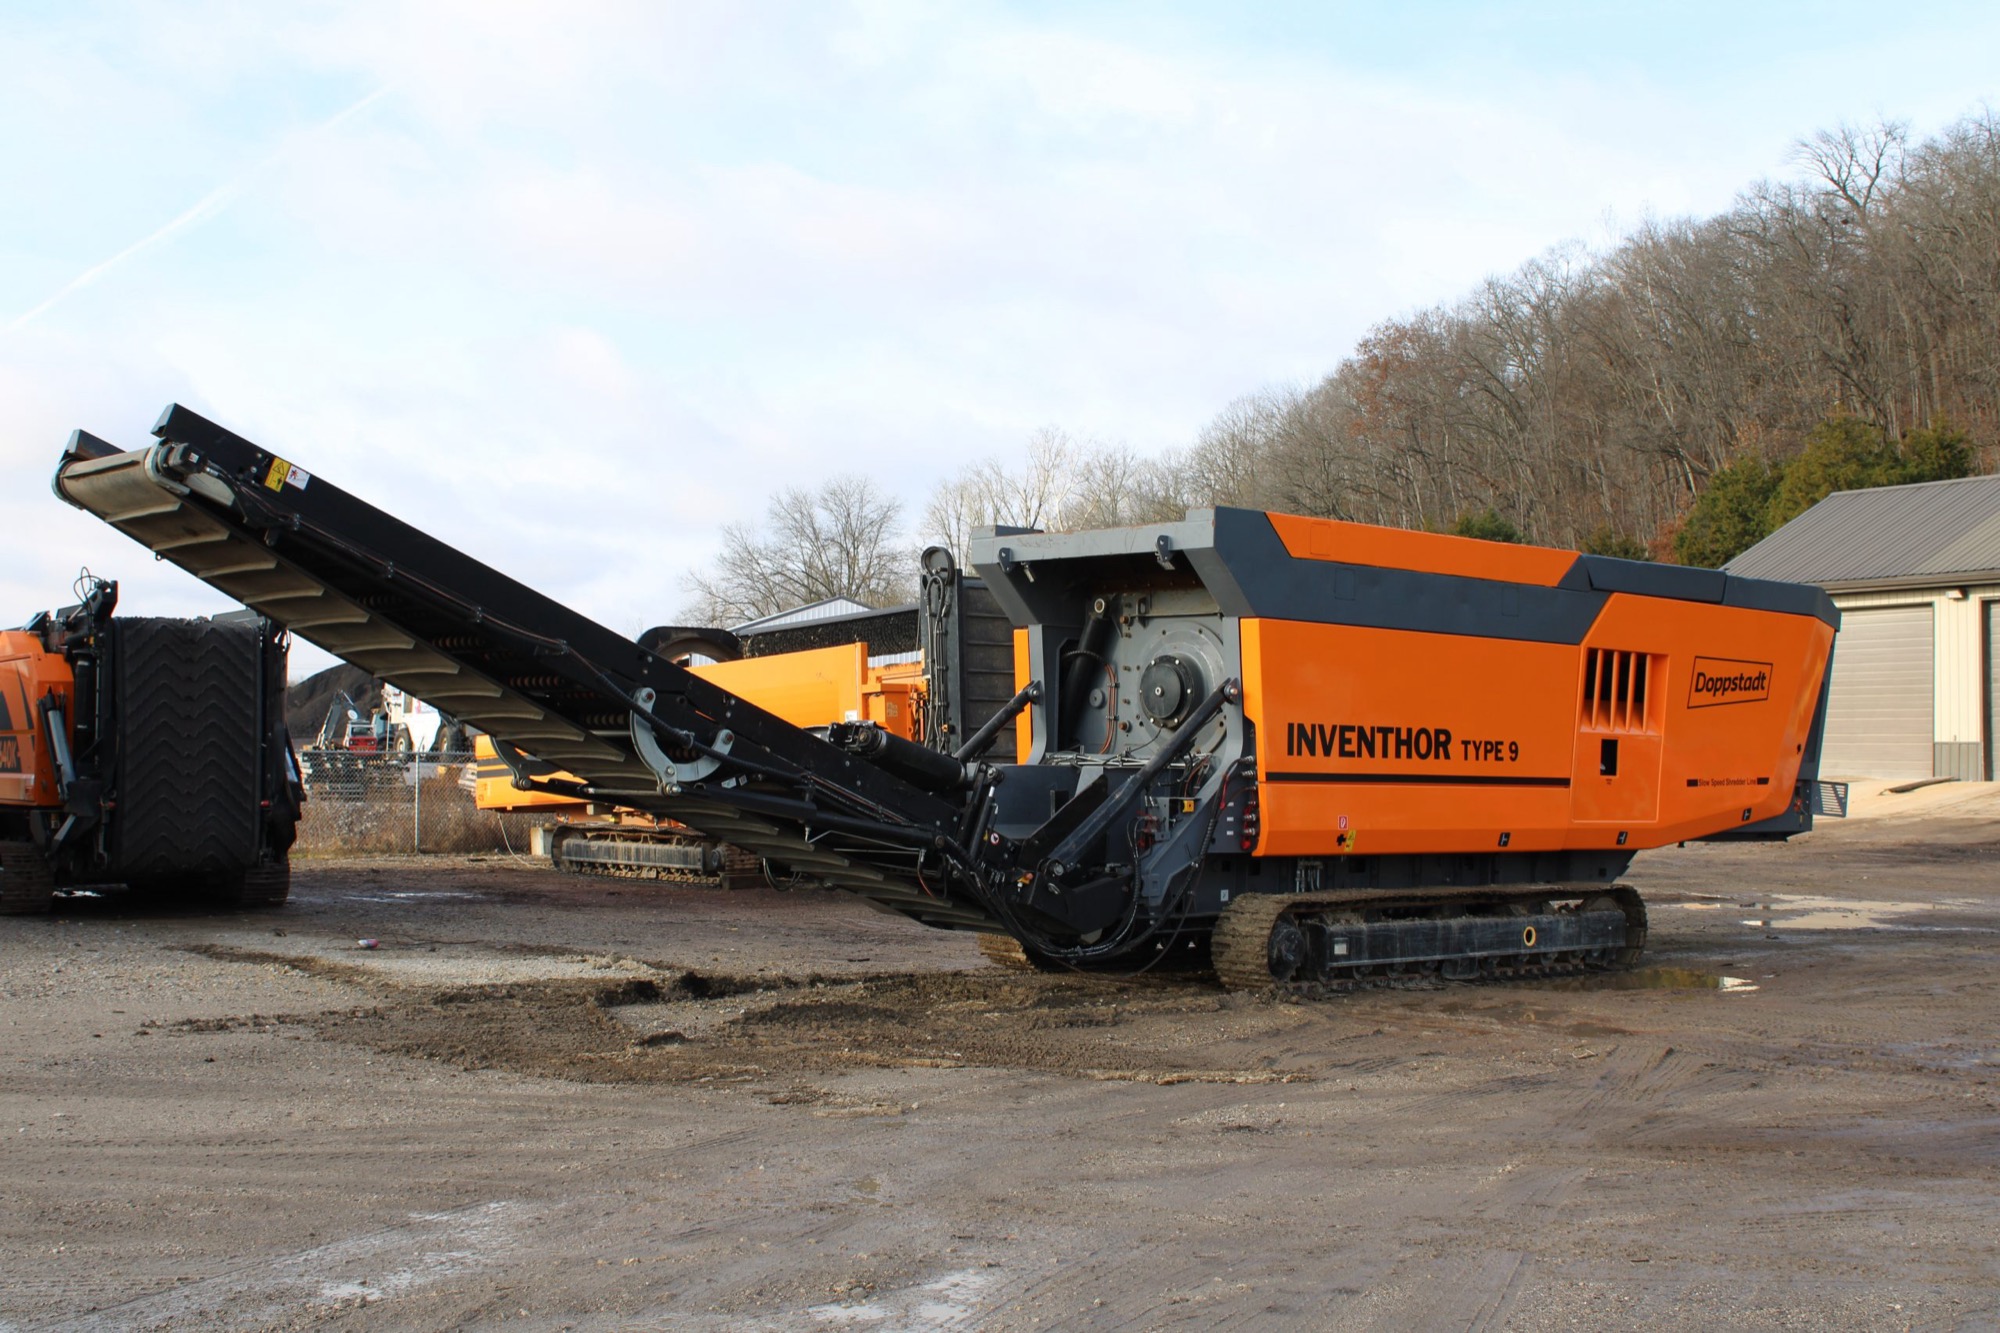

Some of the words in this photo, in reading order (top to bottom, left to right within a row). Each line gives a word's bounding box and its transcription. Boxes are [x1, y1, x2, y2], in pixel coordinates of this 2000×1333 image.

[1694, 671, 1766, 697] Doppstadt
[1286, 722, 1452, 760] INVENTHOR
[1461, 740, 1504, 761] TYPE
[1508, 741, 1519, 762] 9
[1711, 778, 1725, 787] Speed
[1725, 777, 1746, 786] Shredder
[1746, 776, 1757, 785] Line
